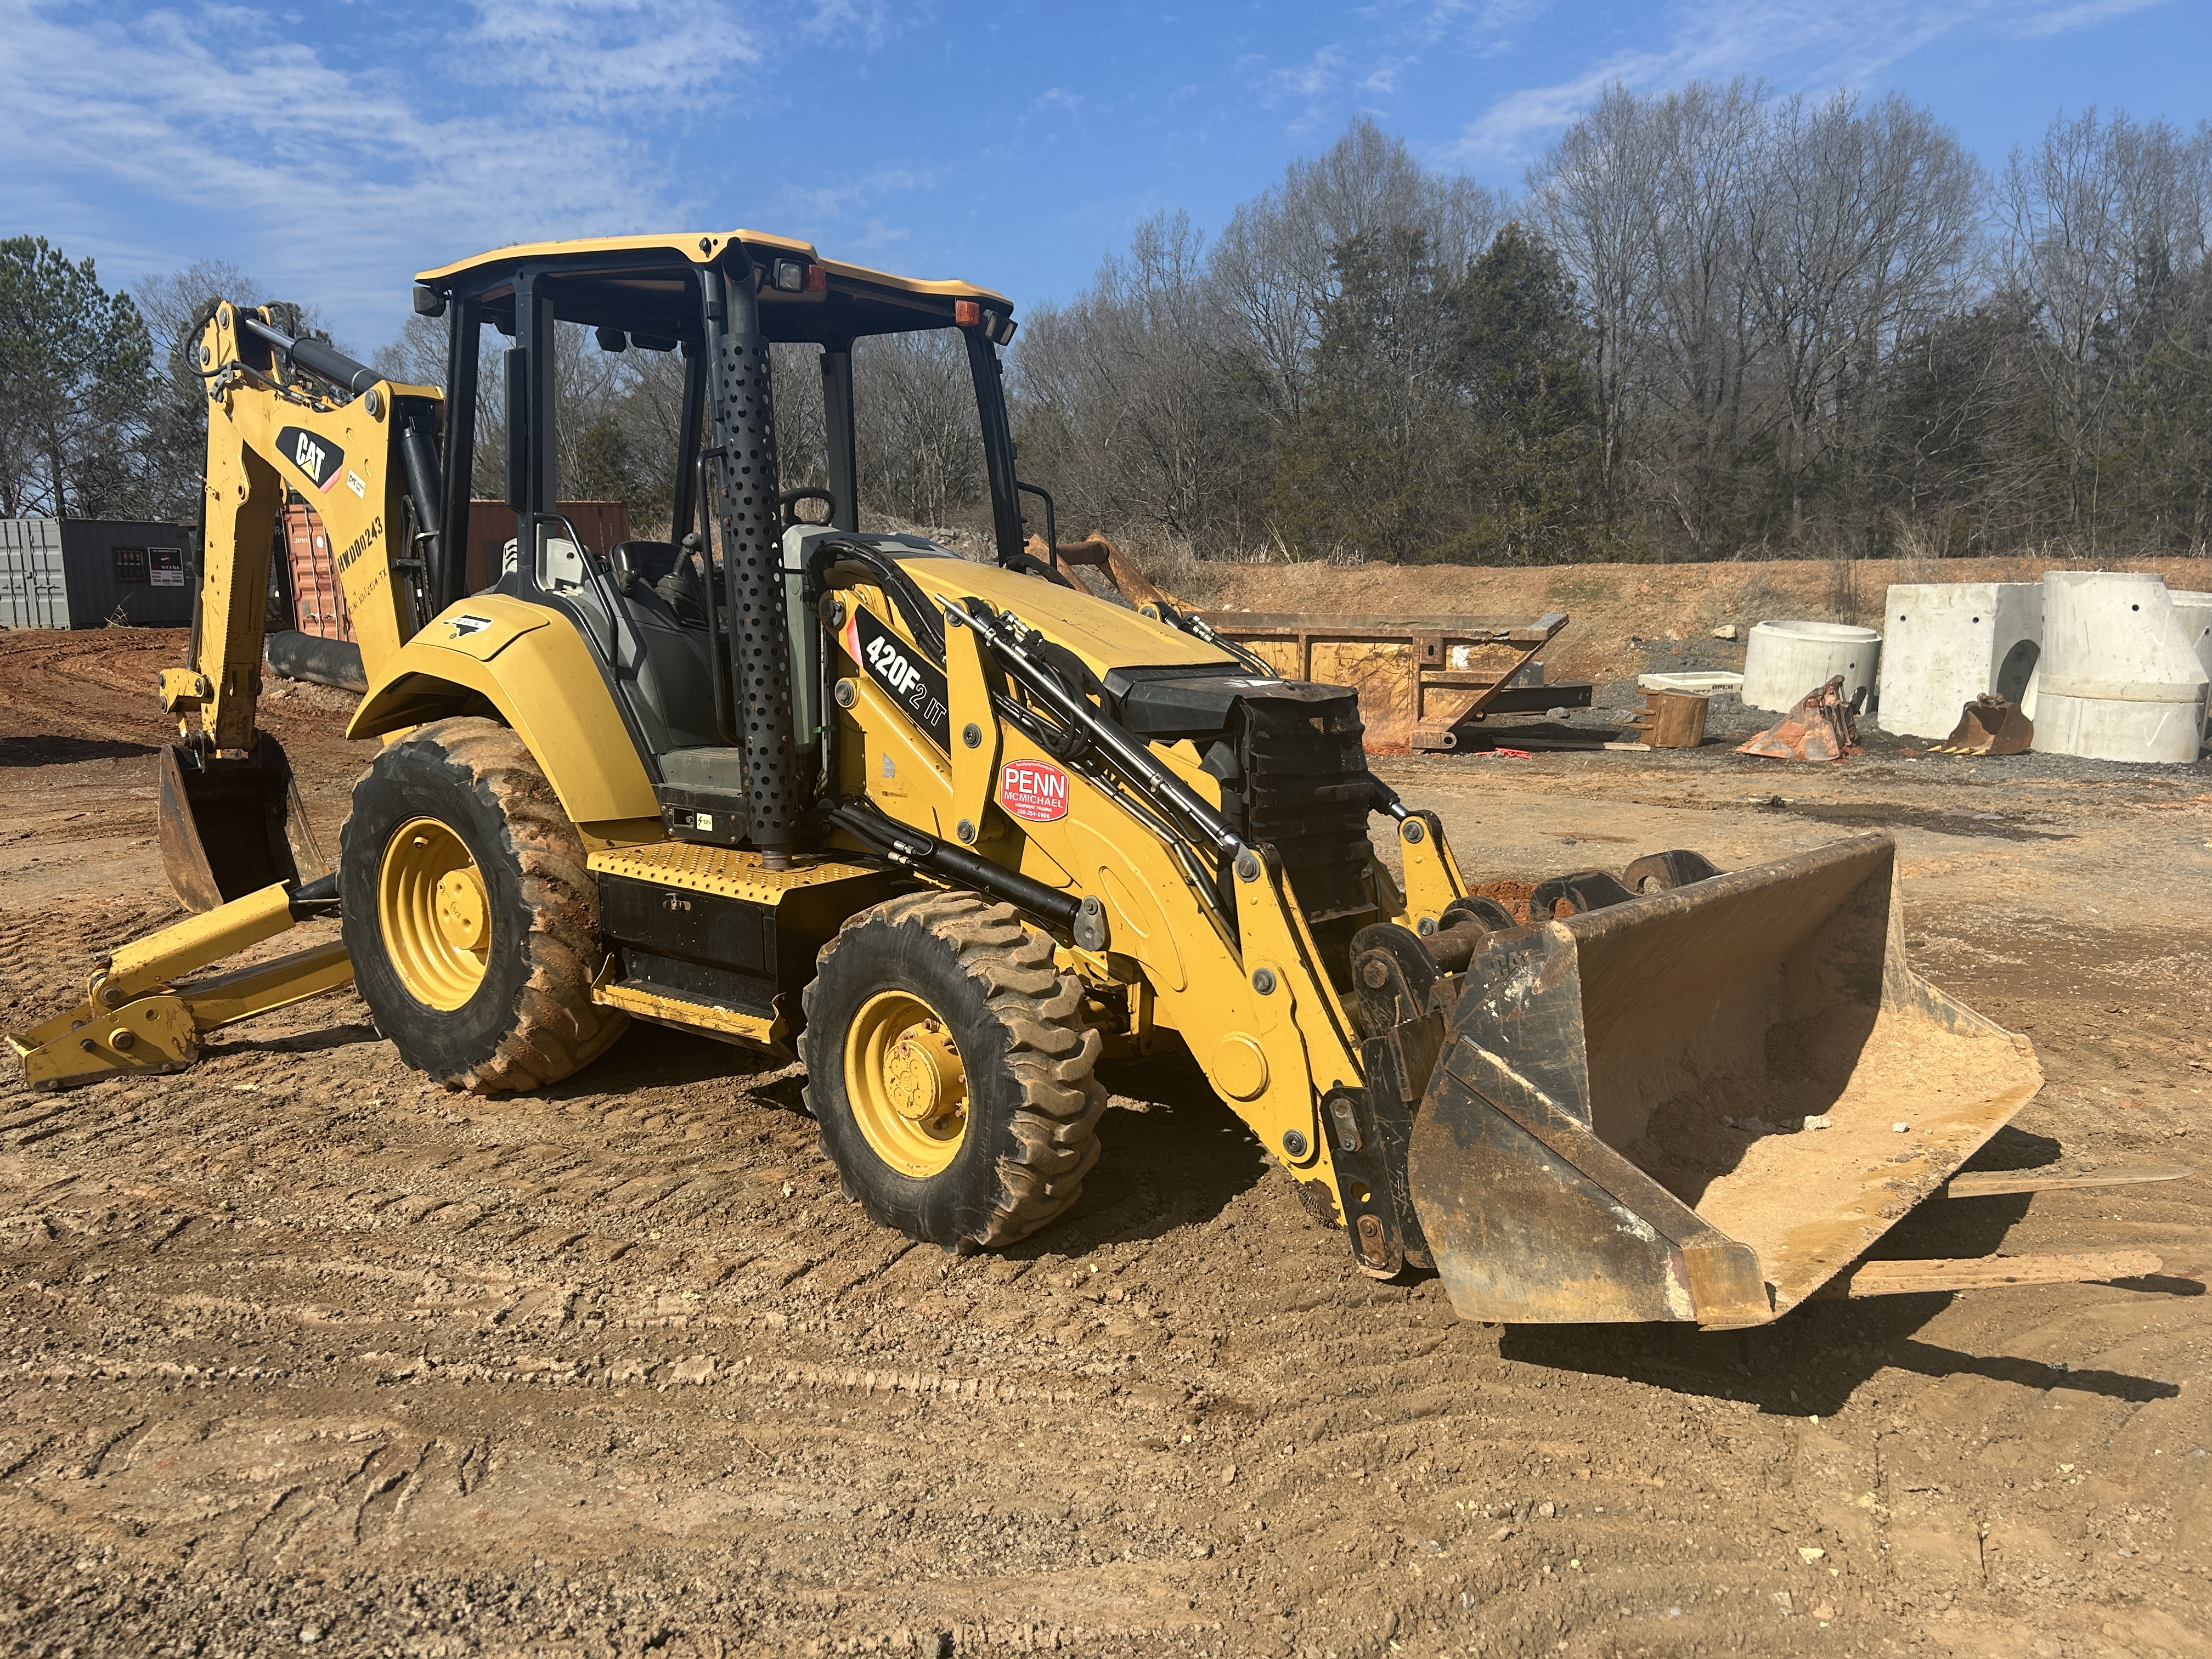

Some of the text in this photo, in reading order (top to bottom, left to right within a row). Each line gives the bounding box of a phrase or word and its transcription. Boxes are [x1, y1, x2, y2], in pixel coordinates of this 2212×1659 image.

[296, 432, 325, 483] CAT
[337, 516, 382, 573] HWD00243
[923, 697, 947, 726] IT
[1005, 768, 1065, 799] PENN
[1004, 791, 1064, 808] MCMICHAEL
[1492, 949, 1533, 981] CAT
